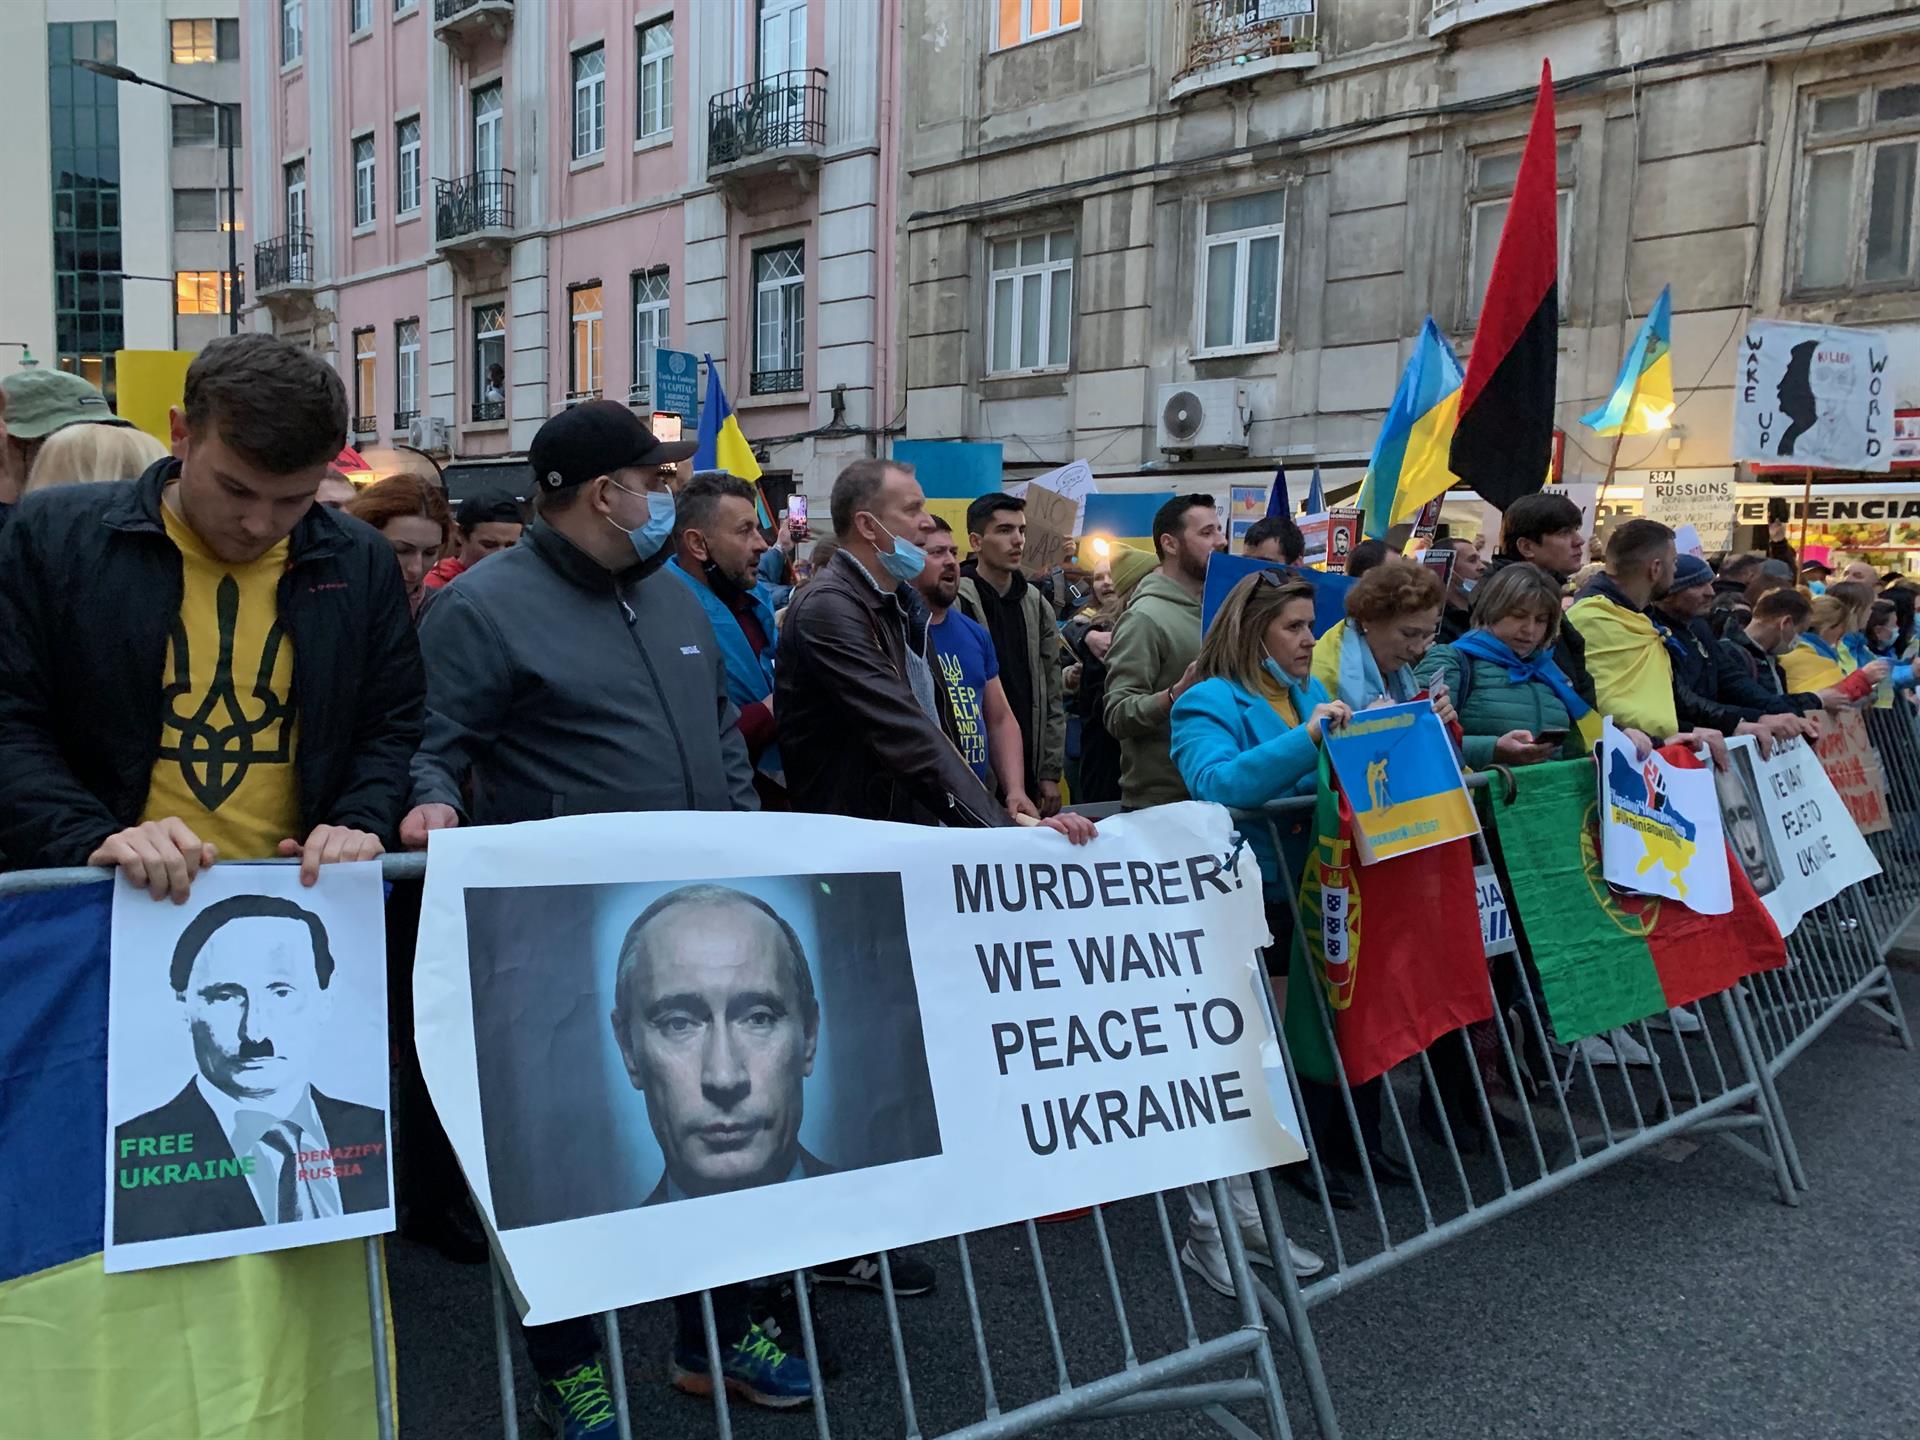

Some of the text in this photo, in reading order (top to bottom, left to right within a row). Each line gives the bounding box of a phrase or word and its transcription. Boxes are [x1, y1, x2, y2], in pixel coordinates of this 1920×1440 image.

[1744, 335, 1763, 403] WAKE
[1866, 347, 1888, 457] WORLD
[1758, 412, 1773, 449] UP
[1034, 489, 1068, 528] NO
[952, 852, 1243, 914] MURDERER!
[975, 929, 1205, 994] WE WANT
[991, 998, 1244, 1076] PEACE TO
[1021, 1071, 1251, 1156] UKRAINE
[120, 1133, 194, 1159] FREE
[298, 1143, 383, 1164] DENAZIFY
[120, 1156, 257, 1190] UKRAINE
[298, 1163, 362, 1182] RUSSIA
